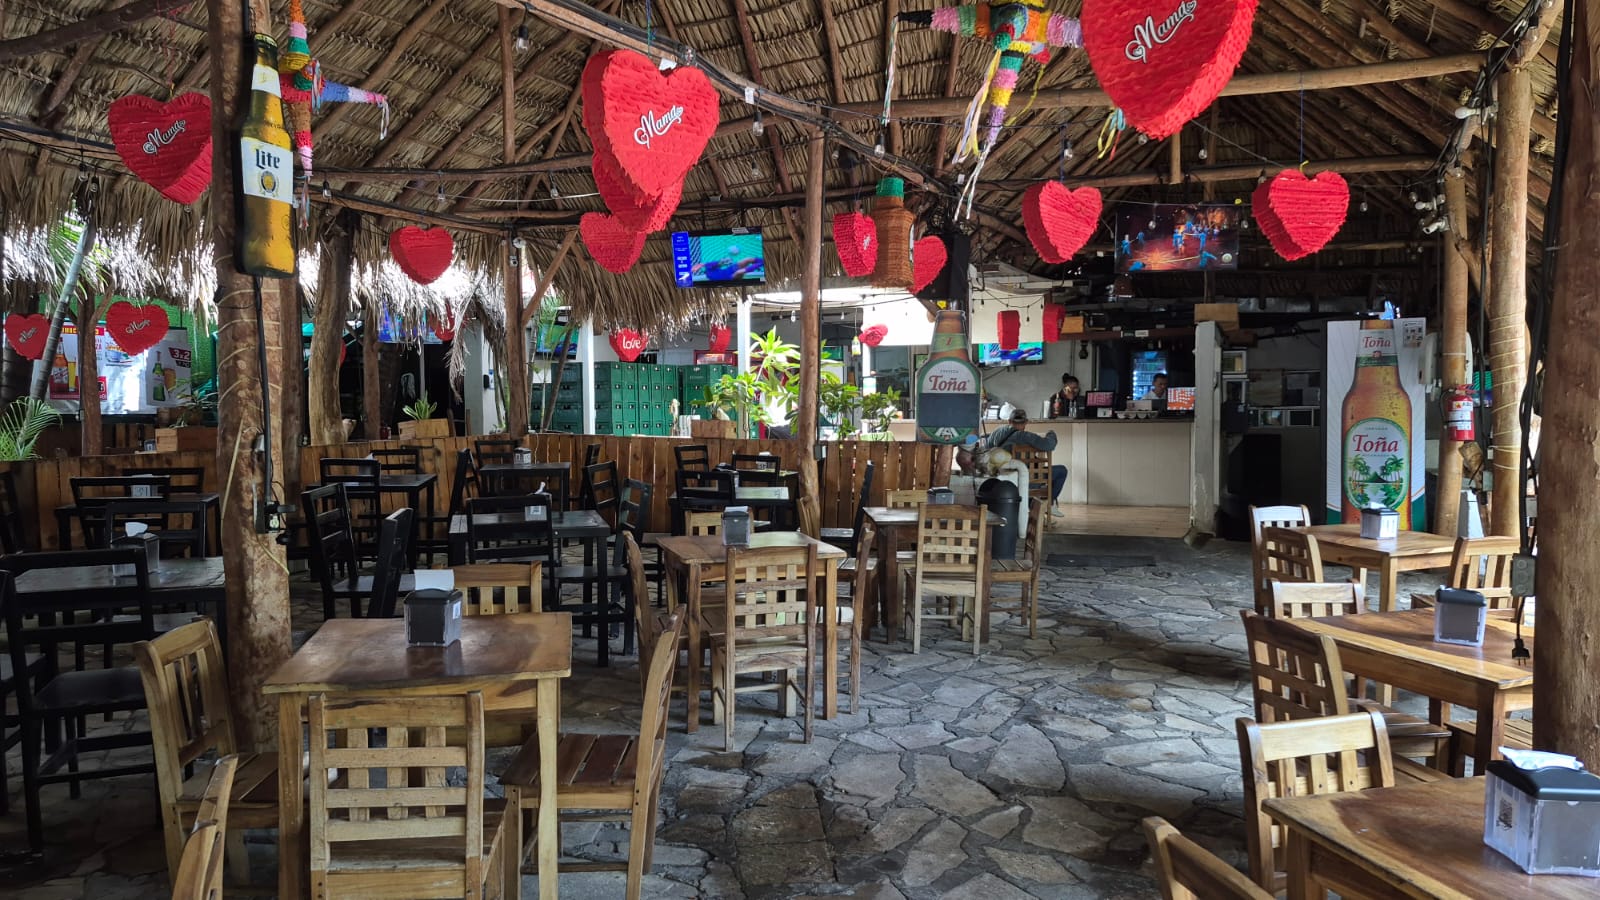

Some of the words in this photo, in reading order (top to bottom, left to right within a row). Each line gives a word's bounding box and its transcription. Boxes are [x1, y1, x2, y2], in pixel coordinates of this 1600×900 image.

[255, 148, 281, 170] Lite
[1363, 336, 1392, 348] Toña
[928, 375, 968, 391] Toña
[1352, 434, 1399, 452] Toña
